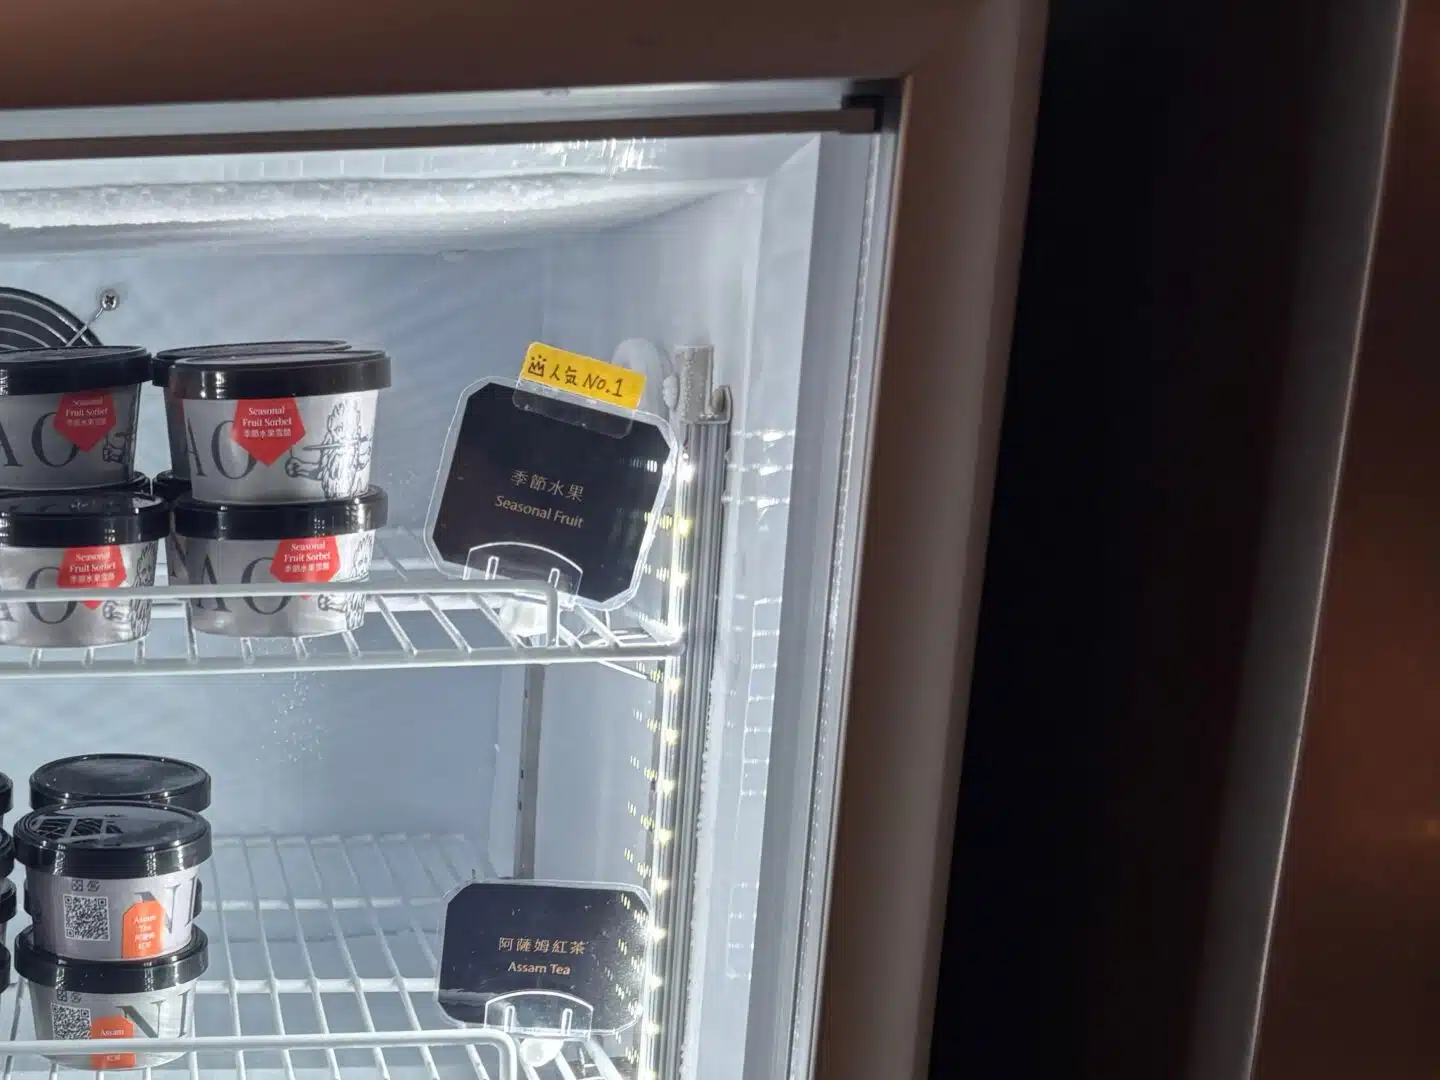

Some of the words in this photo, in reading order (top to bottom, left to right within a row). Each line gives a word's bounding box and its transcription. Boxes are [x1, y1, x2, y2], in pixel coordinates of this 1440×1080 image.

[549, 364, 577, 386] 人気
[582, 373, 624, 397] No.1
[248, 406, 285, 416] Seasonal
[242, 417, 262, 427] Fruit
[264, 416, 292, 426] Sorbet
[511, 469, 585, 501] 季節水果
[494, 495, 552, 519] Seasonal
[553, 509, 585, 528] Fruit
[291, 540, 326, 550] Seasonal
[284, 553, 305, 562] Fruit
[306, 551, 331, 561] Sorbet
[498, 936, 587, 955] 阿薩姆紅茶
[507, 961, 547, 974] Assam
[550, 963, 571, 976] Tea
